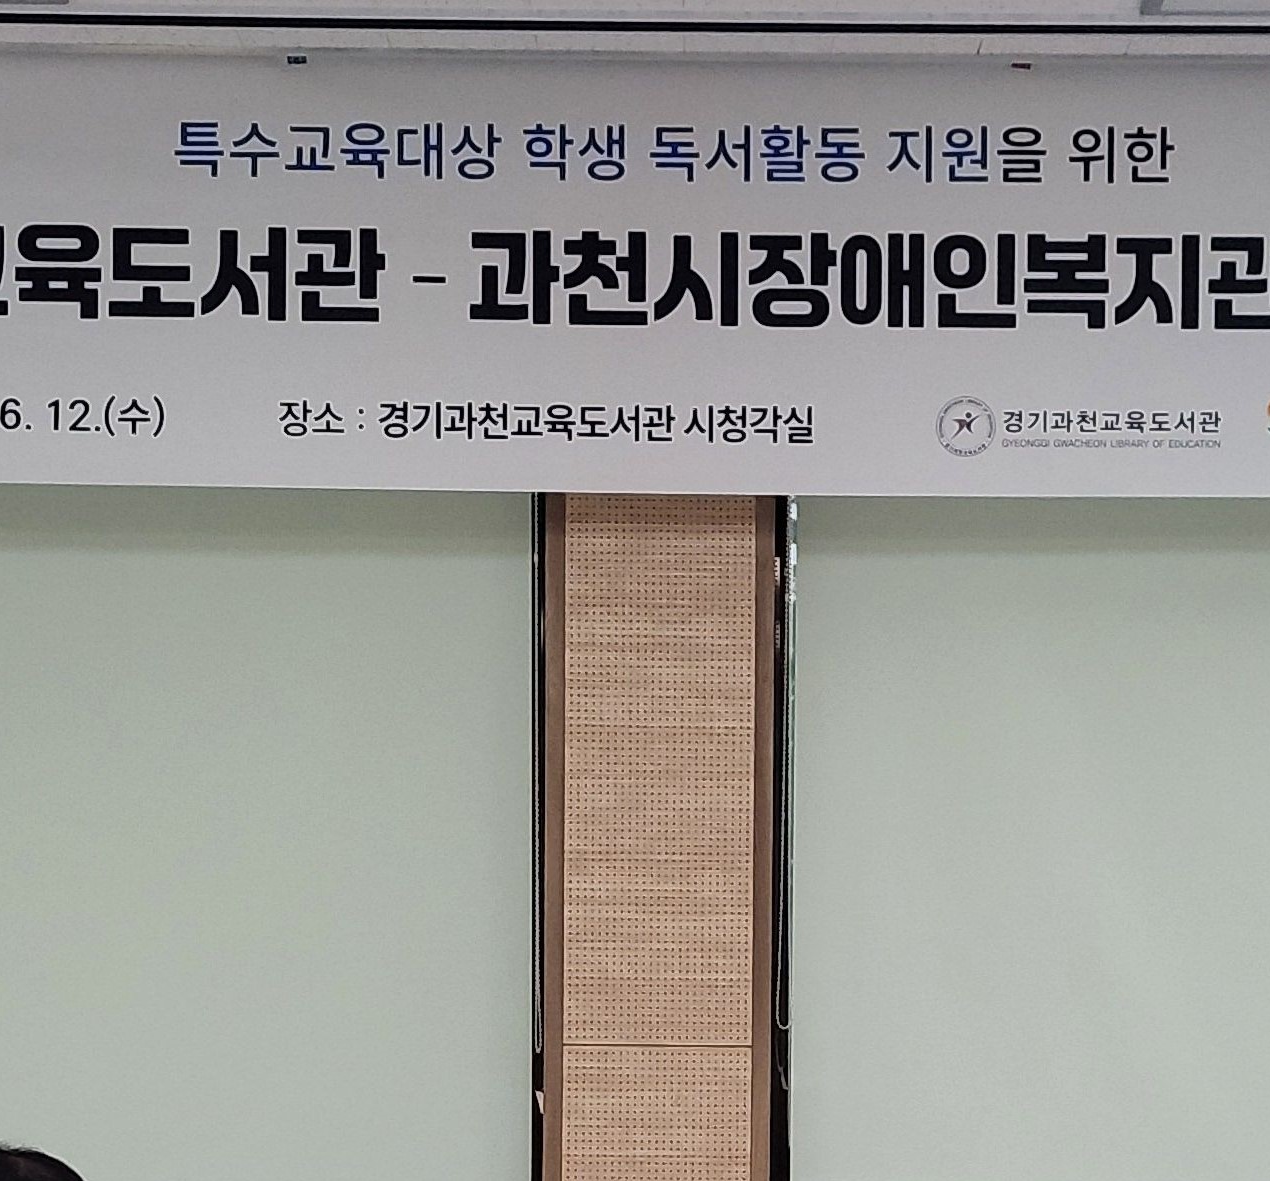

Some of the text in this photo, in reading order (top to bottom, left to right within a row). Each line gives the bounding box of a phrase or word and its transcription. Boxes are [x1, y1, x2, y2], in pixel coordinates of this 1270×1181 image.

[173, 121, 1175, 184] 특수교육대상 학생 독서활동 지원을 위한
[0, 397, 33, 430] 6.
[47, 395, 166, 438] 12.(수)
[277, 401, 345, 439] 장소
[377, 401, 676, 442] 경기과천교육도서관
[683, 403, 815, 444] 시청각실
[1002, 409, 1223, 434] 경기과천교육도서관
